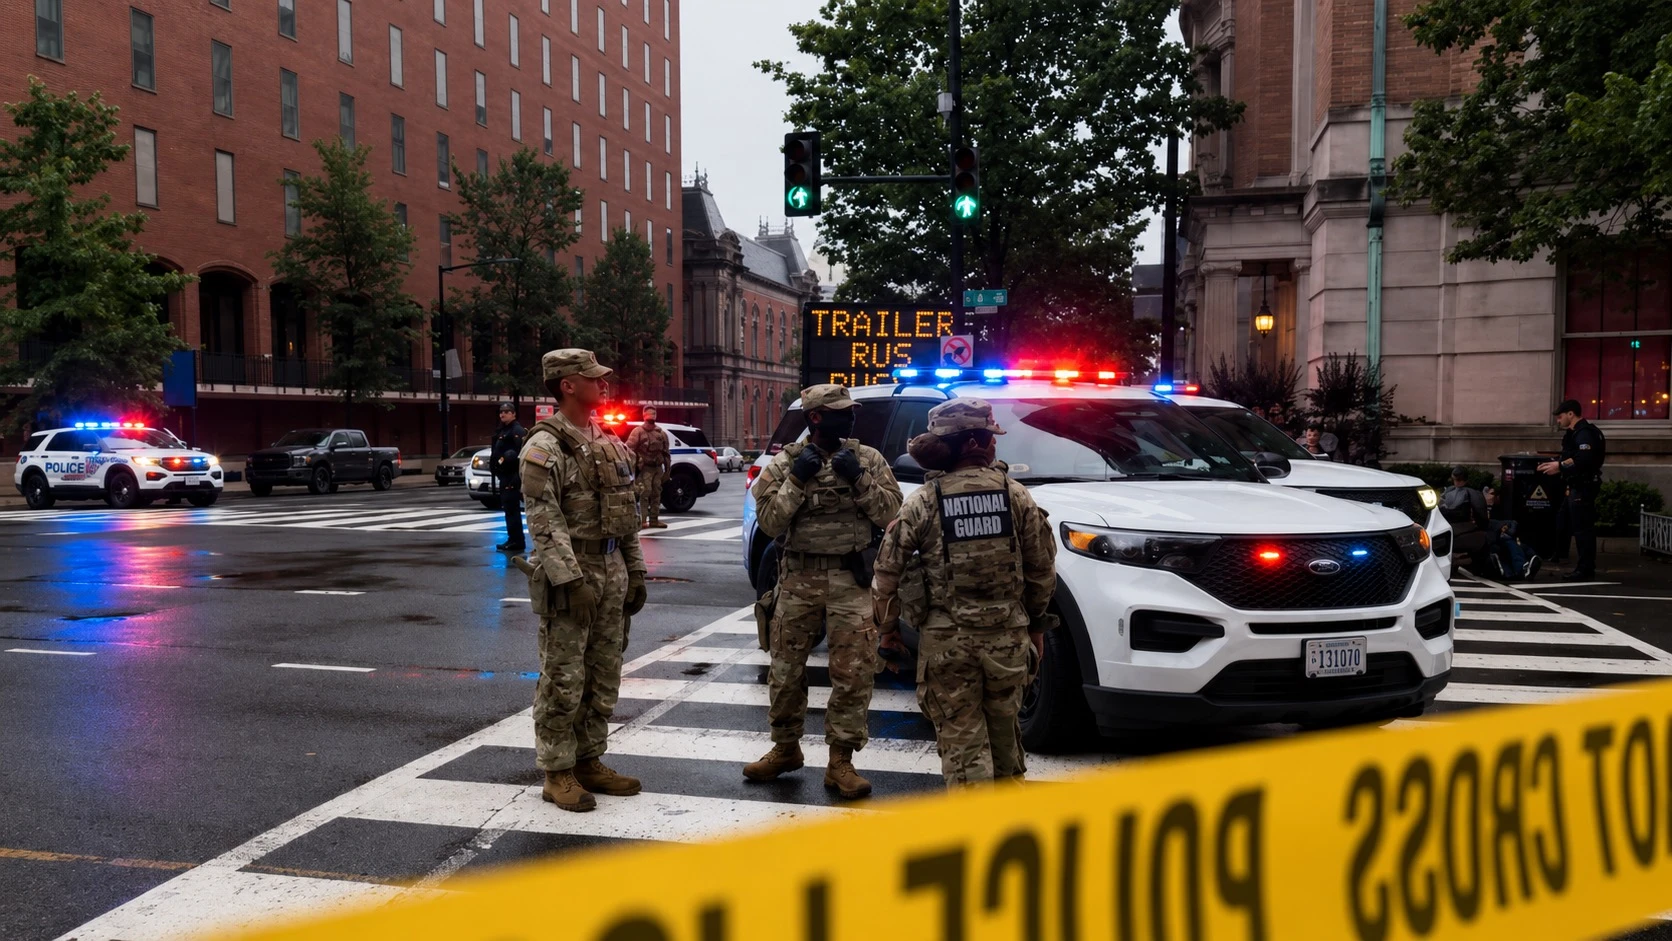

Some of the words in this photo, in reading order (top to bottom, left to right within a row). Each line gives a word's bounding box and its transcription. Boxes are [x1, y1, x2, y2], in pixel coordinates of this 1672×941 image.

[811, 310, 954, 338] TRAILER
[852, 342, 912, 368] RUS
[45, 462, 85, 474] POLICE
[943, 493, 1008, 517] NATIONAL
[954, 515, 1002, 538] GUARD
[1319, 648, 1361, 669] 131070
